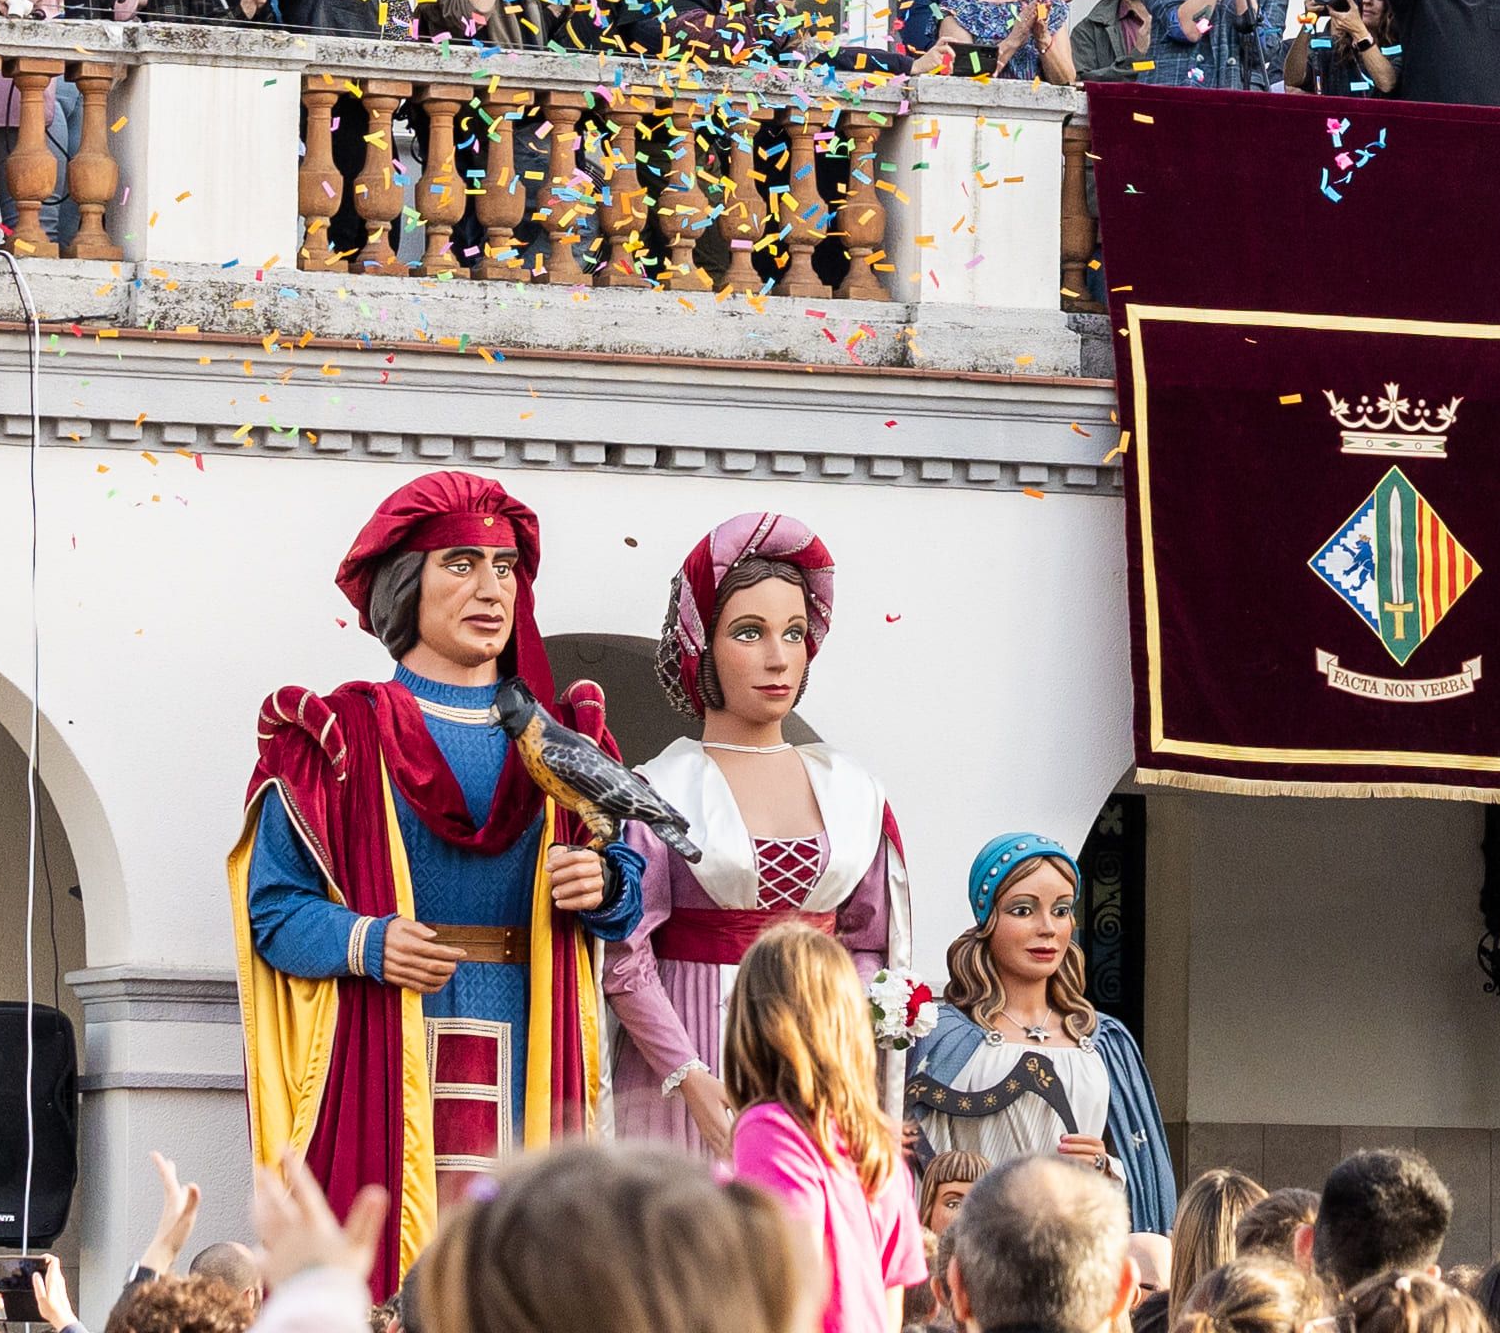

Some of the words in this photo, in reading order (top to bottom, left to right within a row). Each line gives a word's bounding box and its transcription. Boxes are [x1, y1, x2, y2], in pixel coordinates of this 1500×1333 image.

[1333, 671, 1378, 694] FACTA
[1384, 683, 1416, 698] NON
[1420, 677, 1469, 698] VERBA
